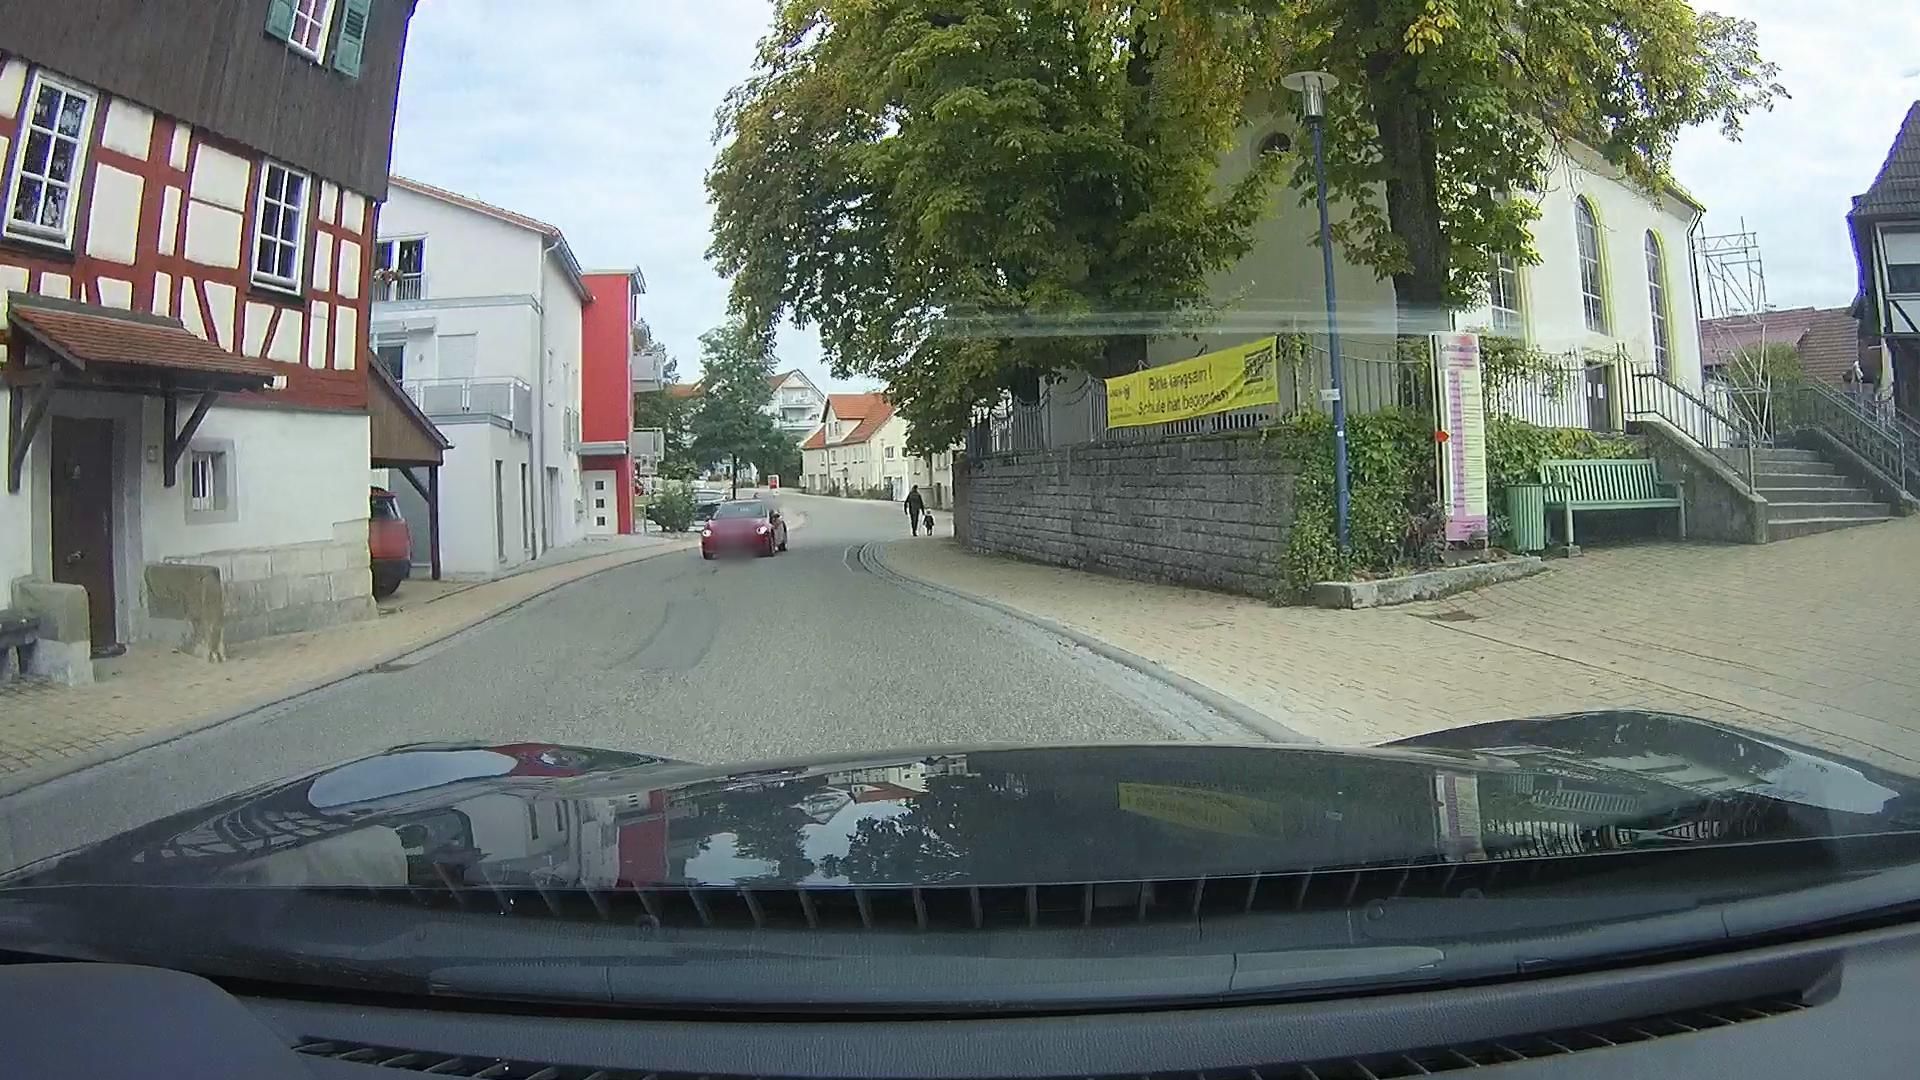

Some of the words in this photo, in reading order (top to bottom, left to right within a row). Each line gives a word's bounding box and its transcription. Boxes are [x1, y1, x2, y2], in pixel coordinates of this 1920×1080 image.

[1148, 376, 1168, 391] Bitte
[1137, 400, 1166, 416] Schule
[1167, 398, 1181, 412] hat
